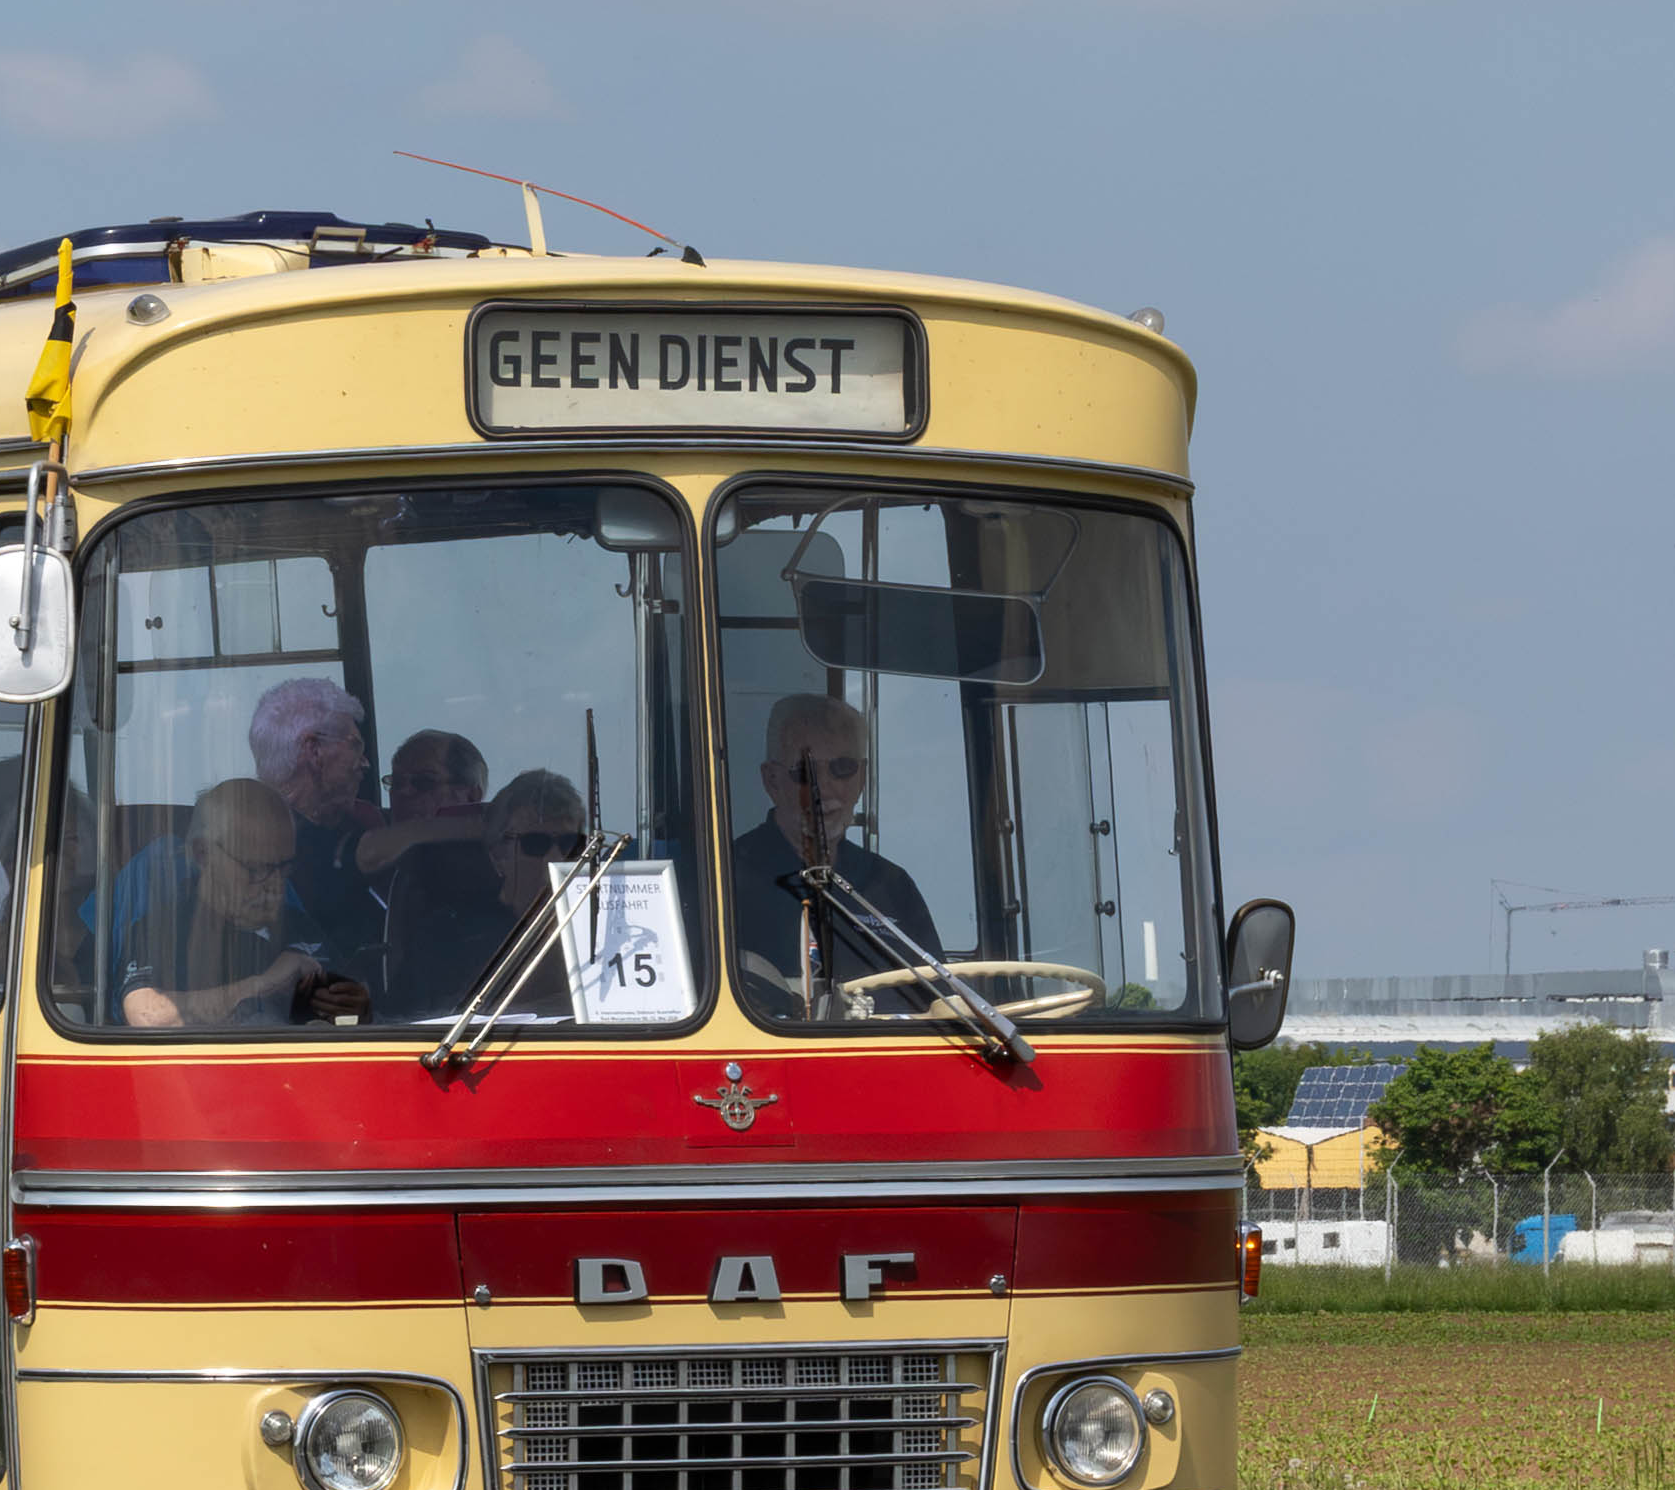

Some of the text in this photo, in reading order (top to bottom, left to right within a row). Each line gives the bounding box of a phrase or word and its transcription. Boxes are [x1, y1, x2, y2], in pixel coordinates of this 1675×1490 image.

[489, 329, 855, 395] GEEN DIENST
[576, 883, 661, 895] STRTNUMMER
[596, 899, 649, 911] USFAHRT
[608, 952, 657, 988] 15
[574, 1252, 916, 1304] DAF
